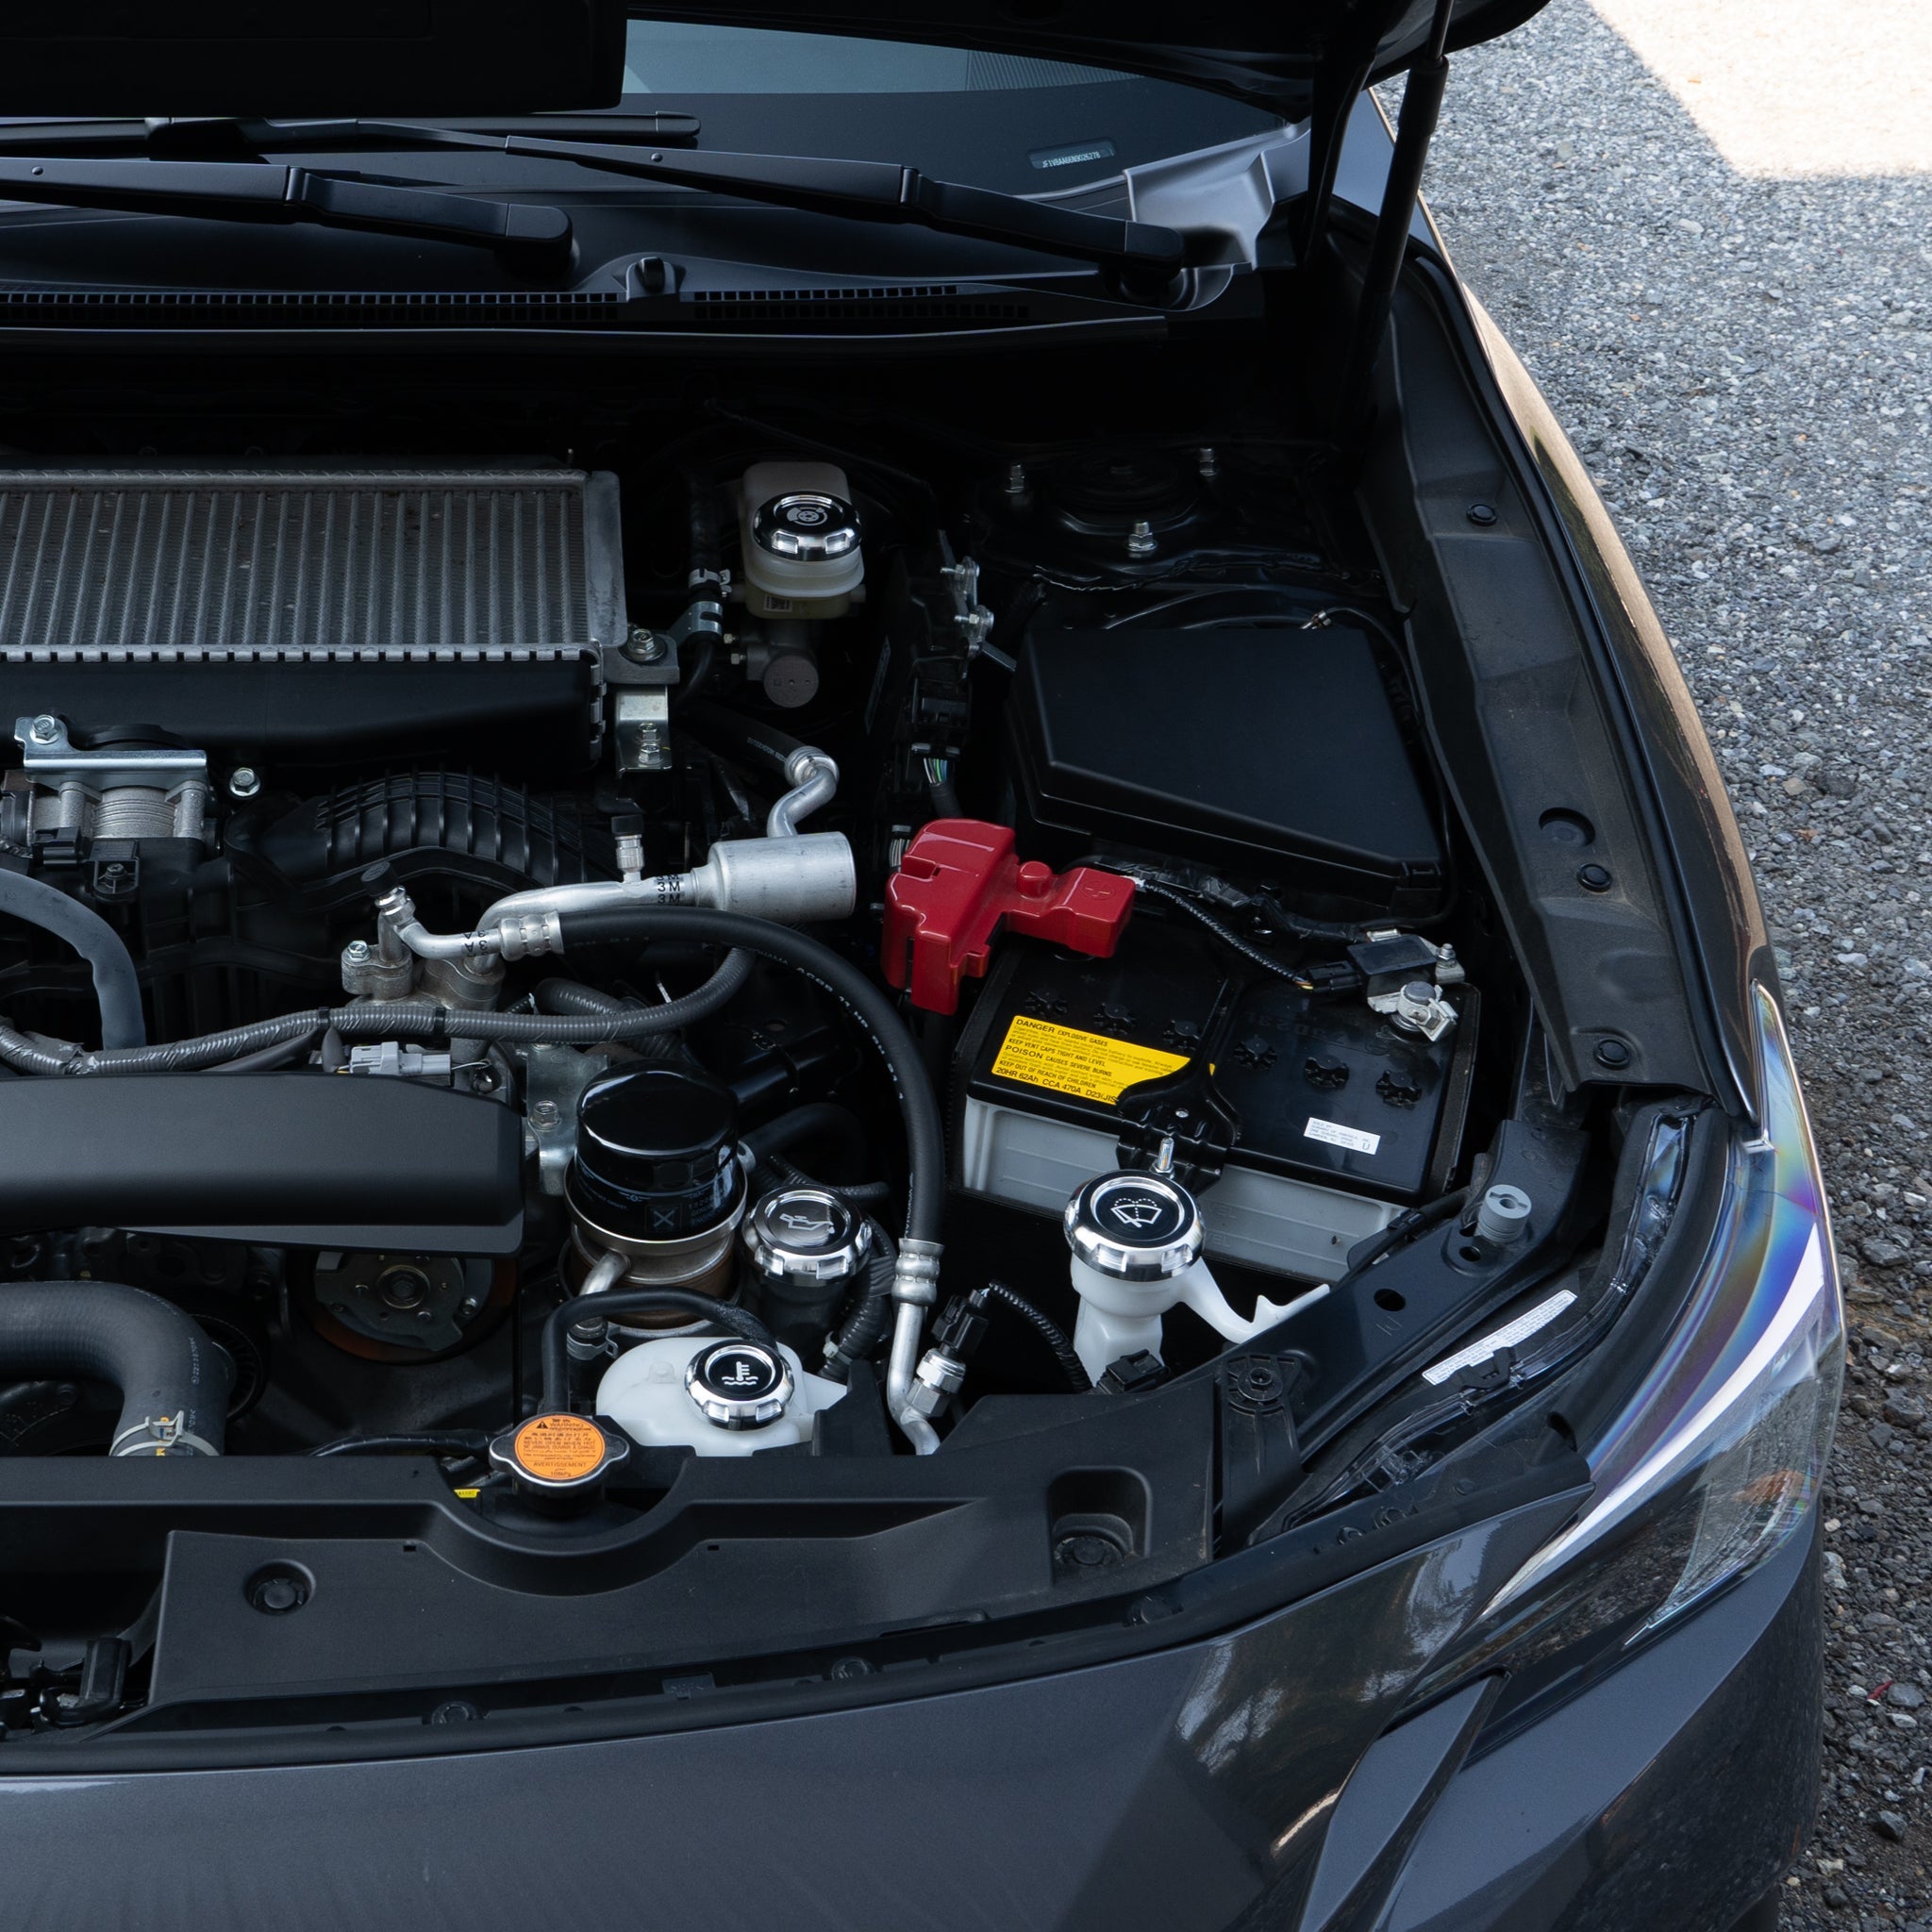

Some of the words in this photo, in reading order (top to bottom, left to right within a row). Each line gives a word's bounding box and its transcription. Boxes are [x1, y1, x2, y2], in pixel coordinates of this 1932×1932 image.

[1015, 1019, 1056, 1033] DANGER
[1057, 1029, 1088, 1041] EXPLOSIVE
[1089, 1038, 1108, 1046] GASES
[1004, 1044, 1043, 1059] POISON
[1044, 1056, 1068, 1065] CAUSES
[1069, 1061, 1091, 1071] SEVERE
[1091, 1067, 1112, 1076] BURNS
[1024, 1041, 1039, 1050] VENT
[1040, 1045, 1056, 1054] CAPS
[1056, 1049, 1074, 1058] TIGHT
[1088, 1058, 1106, 1066] LEVEL
[995, 1067, 1018, 1076] 20HR
[1018, 1073, 1039, 1082] 62Ah
[1041, 1078, 1060, 1088] CCA
[1061, 1083, 1082, 1093] 470A
[1036, 1069, 1057, 1078] REACH
[1068, 1076, 1096, 1088] CHILDREN
